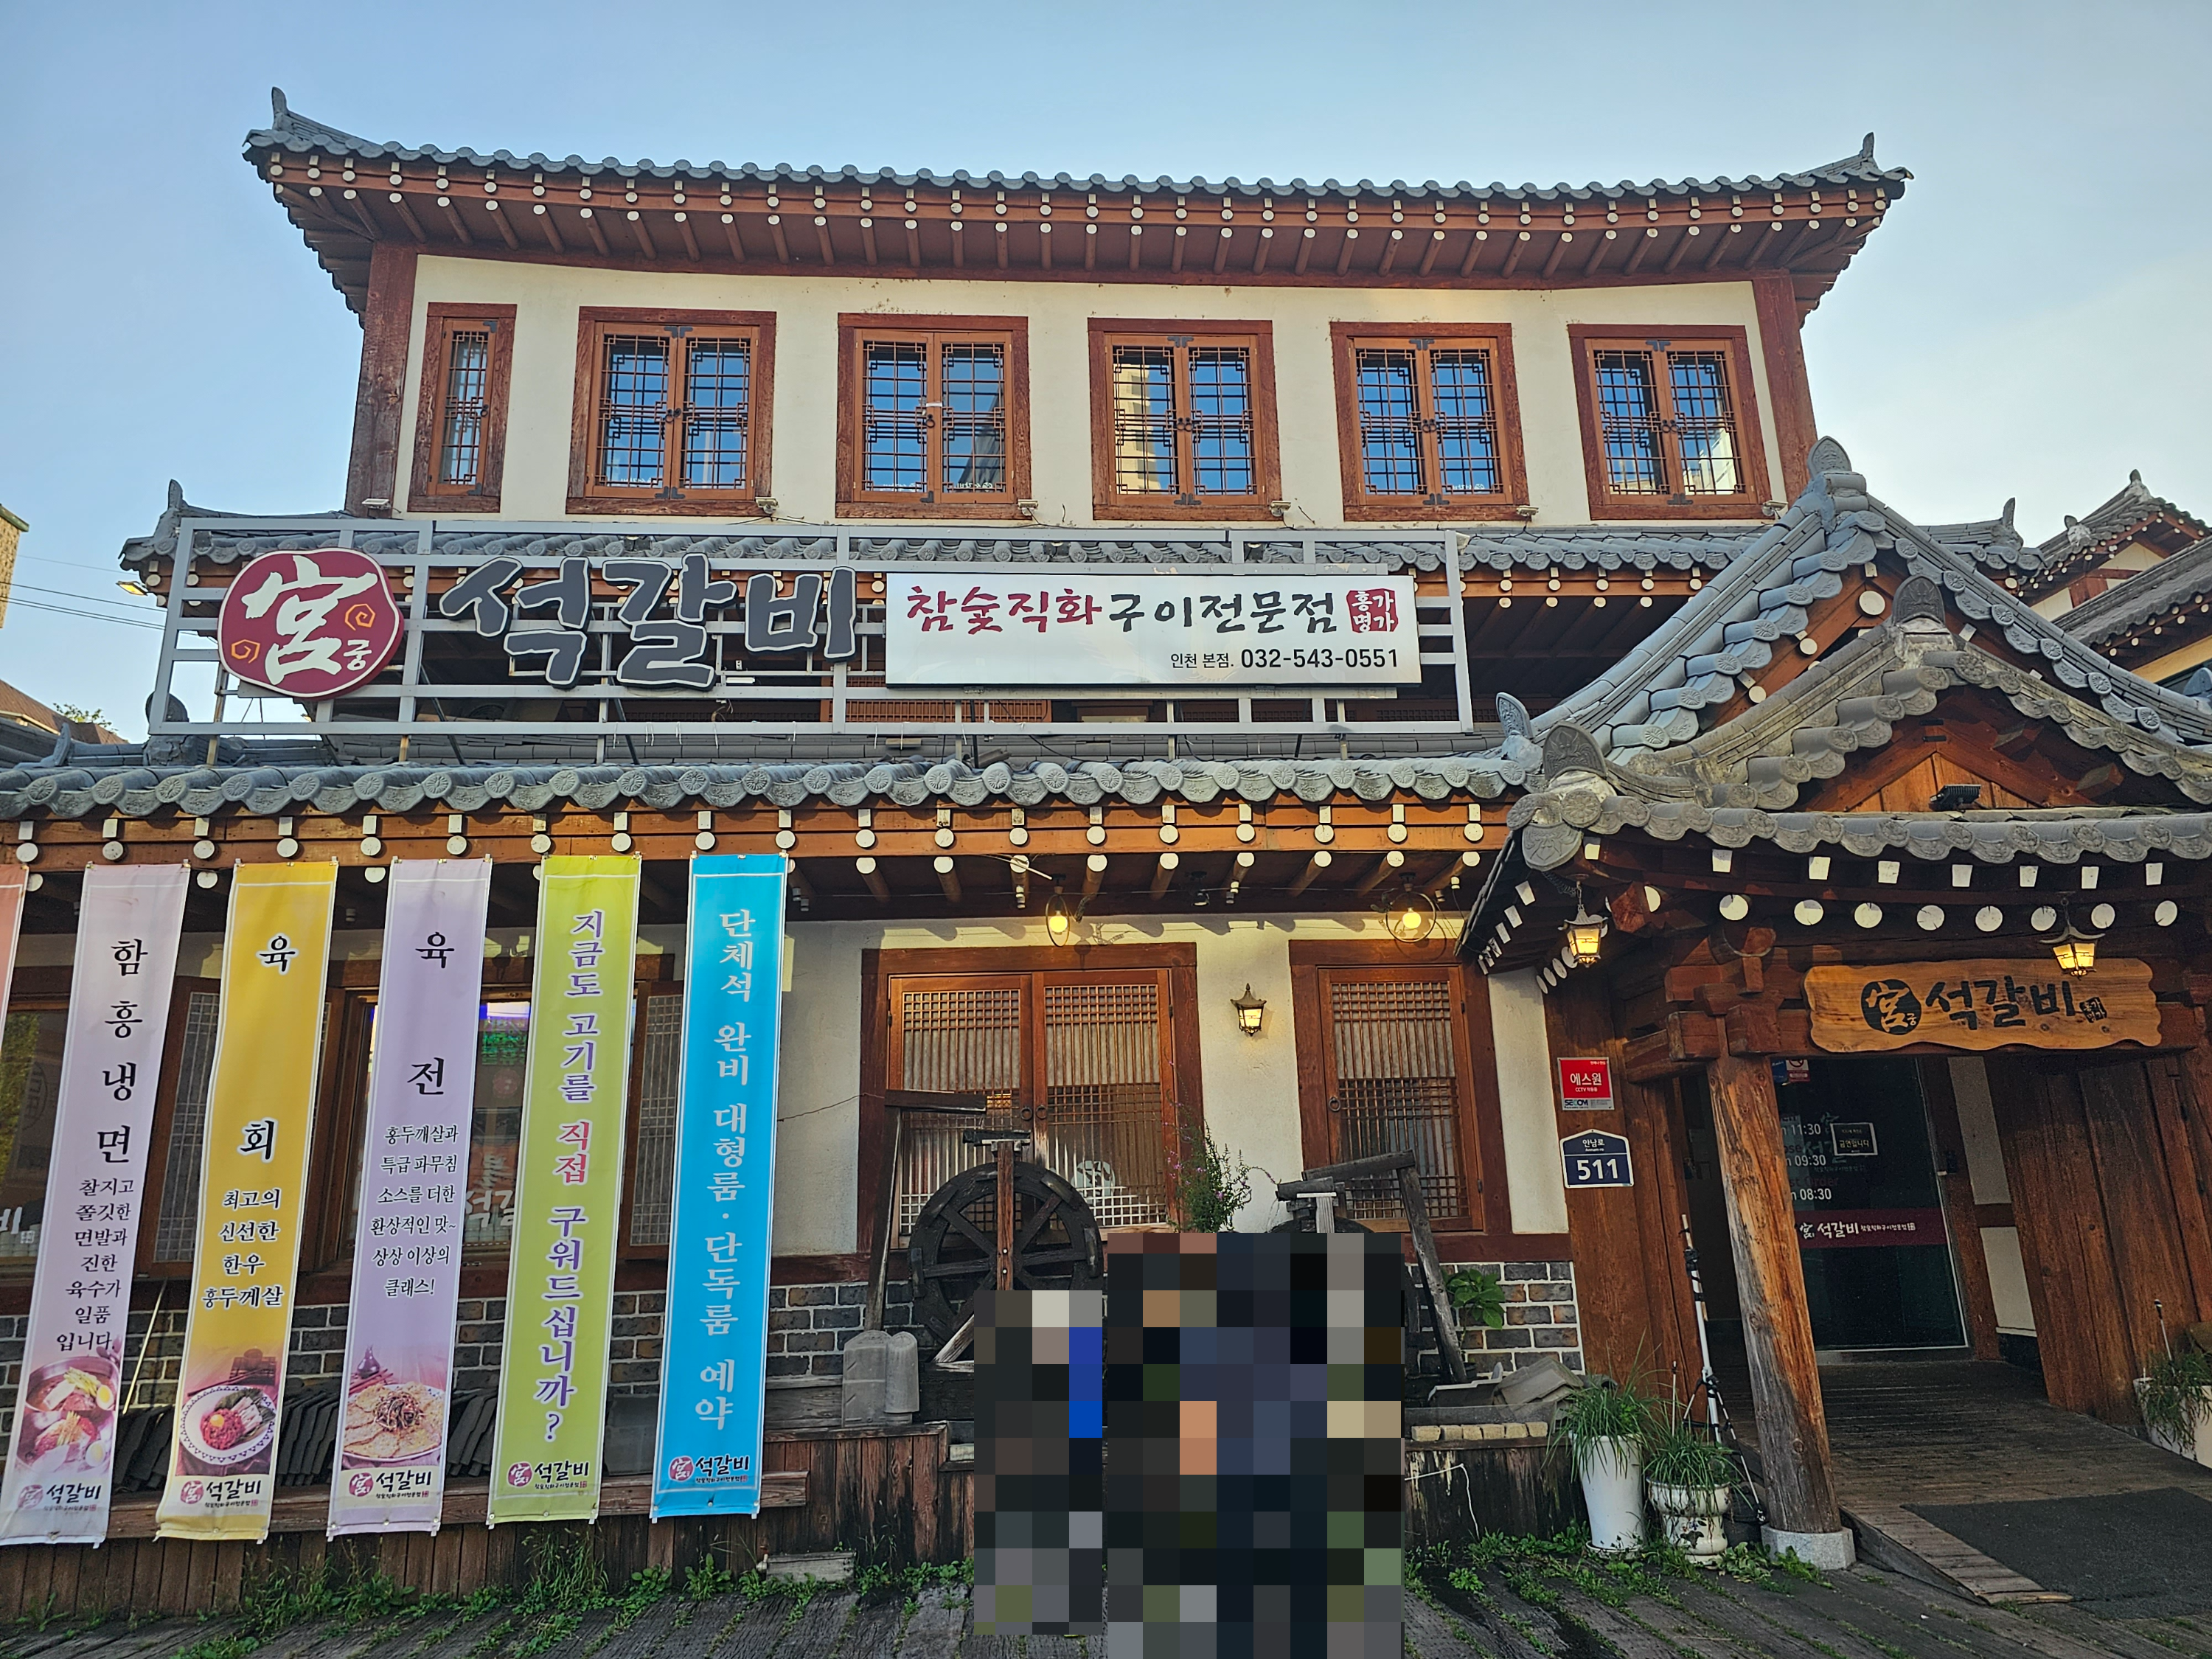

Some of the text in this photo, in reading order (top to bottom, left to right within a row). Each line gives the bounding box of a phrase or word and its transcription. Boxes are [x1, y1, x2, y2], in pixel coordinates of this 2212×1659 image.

[441, 552, 856, 689] 석갈비
[343, 639, 372, 671] 궁
[1171, 653, 1197, 669] 인천
[1241, 649, 1398, 668] 032-543-0551
[566, 911, 604, 997] 지금도
[719, 909, 756, 1003] 단체석
[1925, 975, 2075, 1030] 석갈비
[97, 938, 148, 1164] 함흥냉면
[560, 1013, 599, 1102] 고기를
[713, 1022, 752, 1085] 완비
[1570, 1072, 1602, 1086] 에스원
[1791, 1124, 1821, 1135] 11:30
[556, 1121, 588, 1184] 직접
[1582, 1138, 1605, 1147] 안남로
[1839, 1140, 1870, 1148] 금연입니다
[380, 1155, 457, 1175] 특급 파무침
[1577, 1158, 1618, 1180] 511
[1795, 1155, 1826, 1166] 09:30
[79, 1178, 134, 1196] 찰지고
[378, 1184, 456, 1204] 소스를 더한
[1800, 1188, 1832, 1200] 08:30
[223, 1189, 280, 1210] 최고의
[75, 1203, 131, 1222] 쫄깃한
[220, 1221, 279, 1242] 신선한
[370, 1216, 430, 1236] 환상적인
[1817, 1221, 1860, 1239] 석갈비
[74, 1228, 128, 1247] 면발과
[80, 1254, 118, 1272] 진한
[223, 1254, 265, 1274] 한우
[372, 1245, 450, 1266] 상상 이상의
[66, 1279, 122, 1298] 육수가
[385, 1278, 434, 1297] 클래스!
[75, 1306, 111, 1324] 일품
[57, 1332, 116, 1352] 입니다.
[695, 1358, 735, 1430] 예약
[535, 1461, 588, 1483] 석갈비
[695, 1454, 749, 1477] 석갈비
[206, 1478, 261, 1501] 석갈비
[376, 1470, 431, 1492] 석갈비
[46, 1483, 101, 1504] 석갈비
